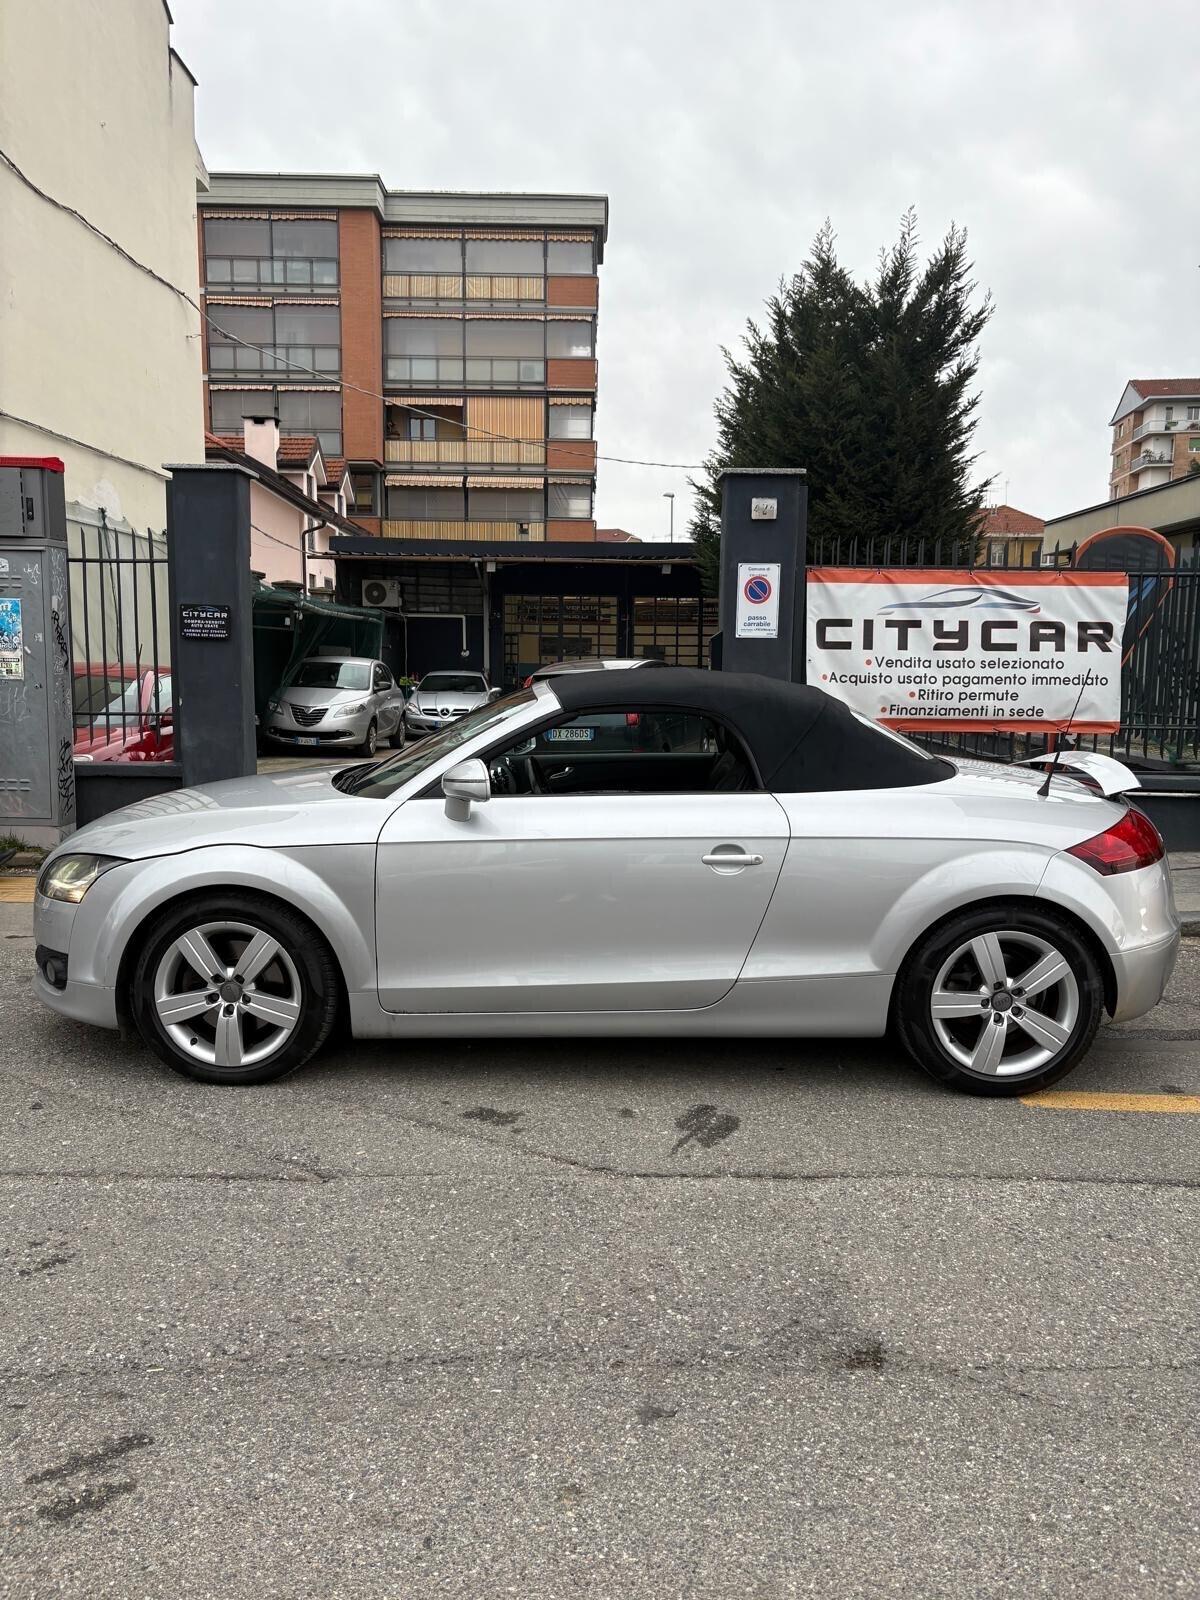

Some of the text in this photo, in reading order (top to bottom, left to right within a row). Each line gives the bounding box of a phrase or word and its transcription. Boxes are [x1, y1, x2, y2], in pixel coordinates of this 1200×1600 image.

[816, 619, 1113, 652] CITYCAR
[875, 657, 1064, 669] Vendita usato selezionato
[829, 672, 1108, 687] Acquisto usato pagamento immediato
[918, 689, 1019, 703] Ritiro permute
[889, 705, 1044, 717] Finanziamenti in sede
[552, 729, 589, 738] DX 286DS
